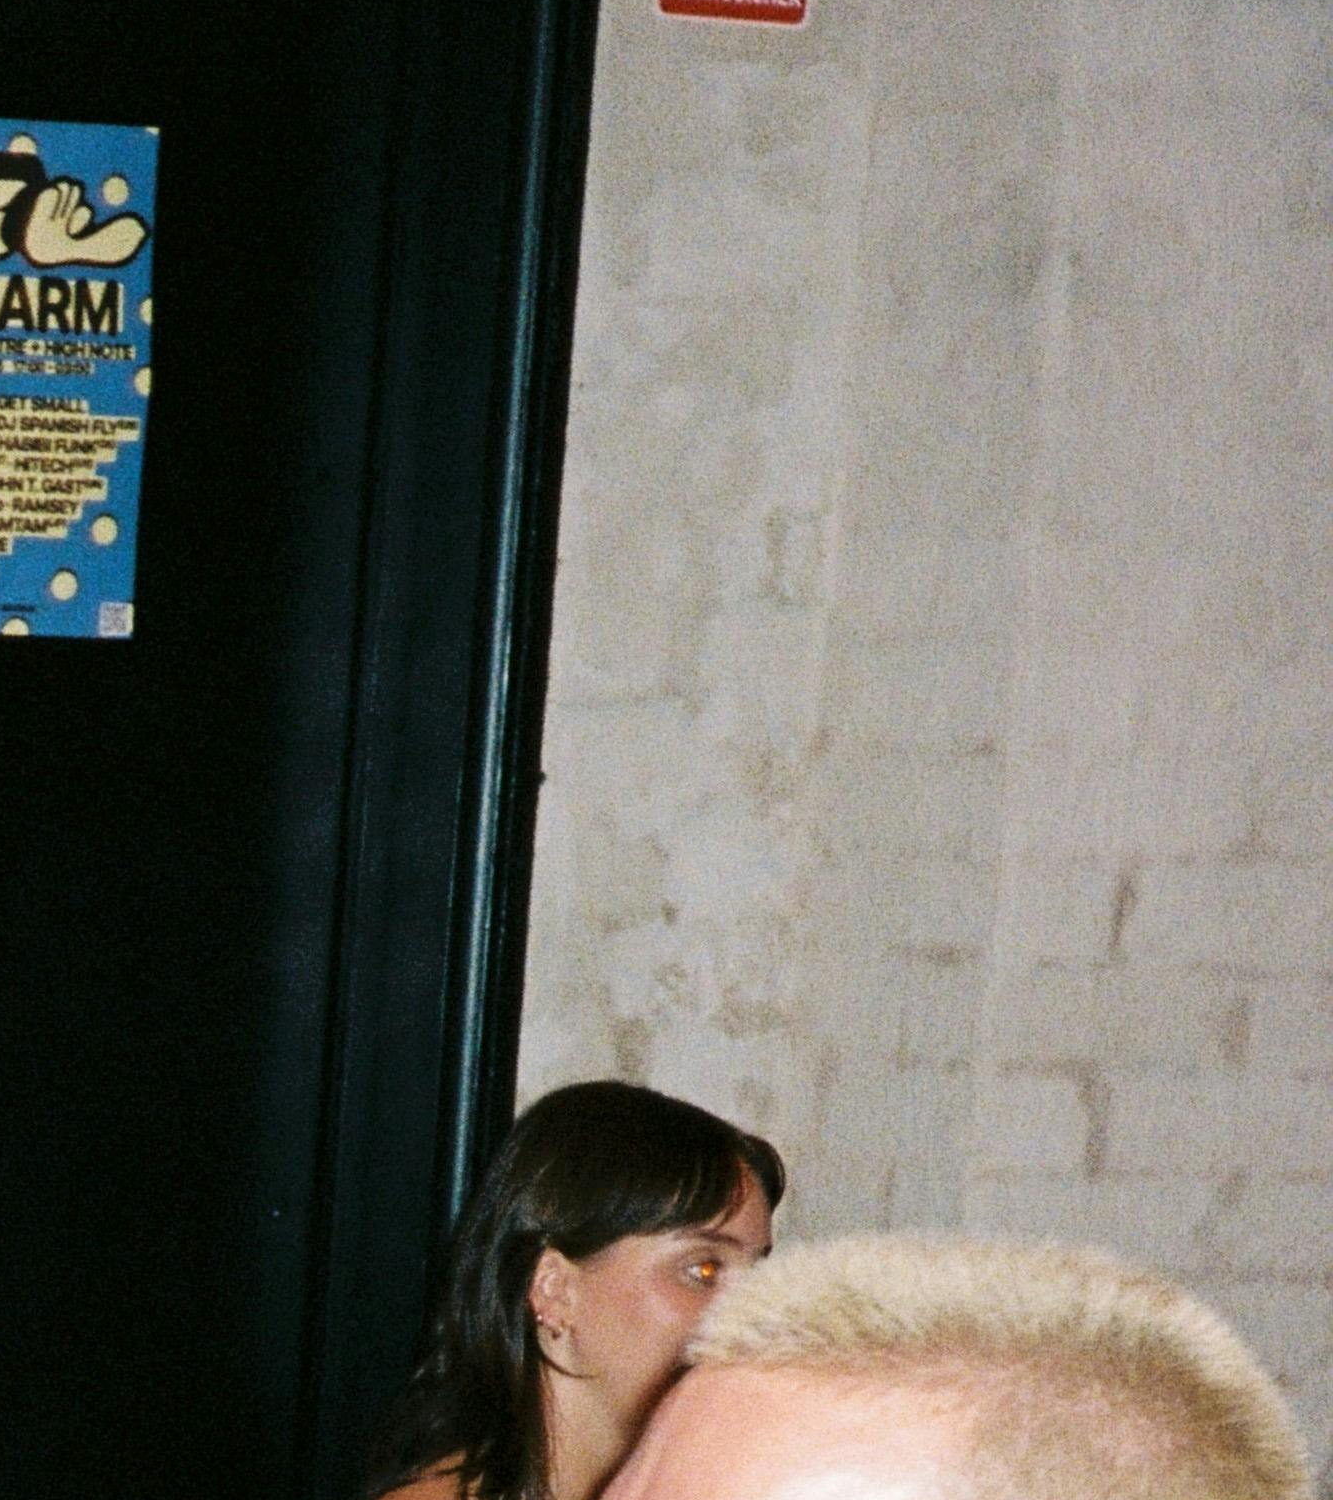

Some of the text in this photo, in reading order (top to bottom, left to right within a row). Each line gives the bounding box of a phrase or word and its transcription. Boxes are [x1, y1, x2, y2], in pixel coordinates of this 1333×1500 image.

[45, 340, 88, 358] HIGH
[89, 342, 134, 360] NOTE
[31, 396, 85, 413] SMALL
[19, 417, 89, 433] SPANISH
[42, 478, 82, 494] GAST
[12, 497, 79, 515] RAMSEY
